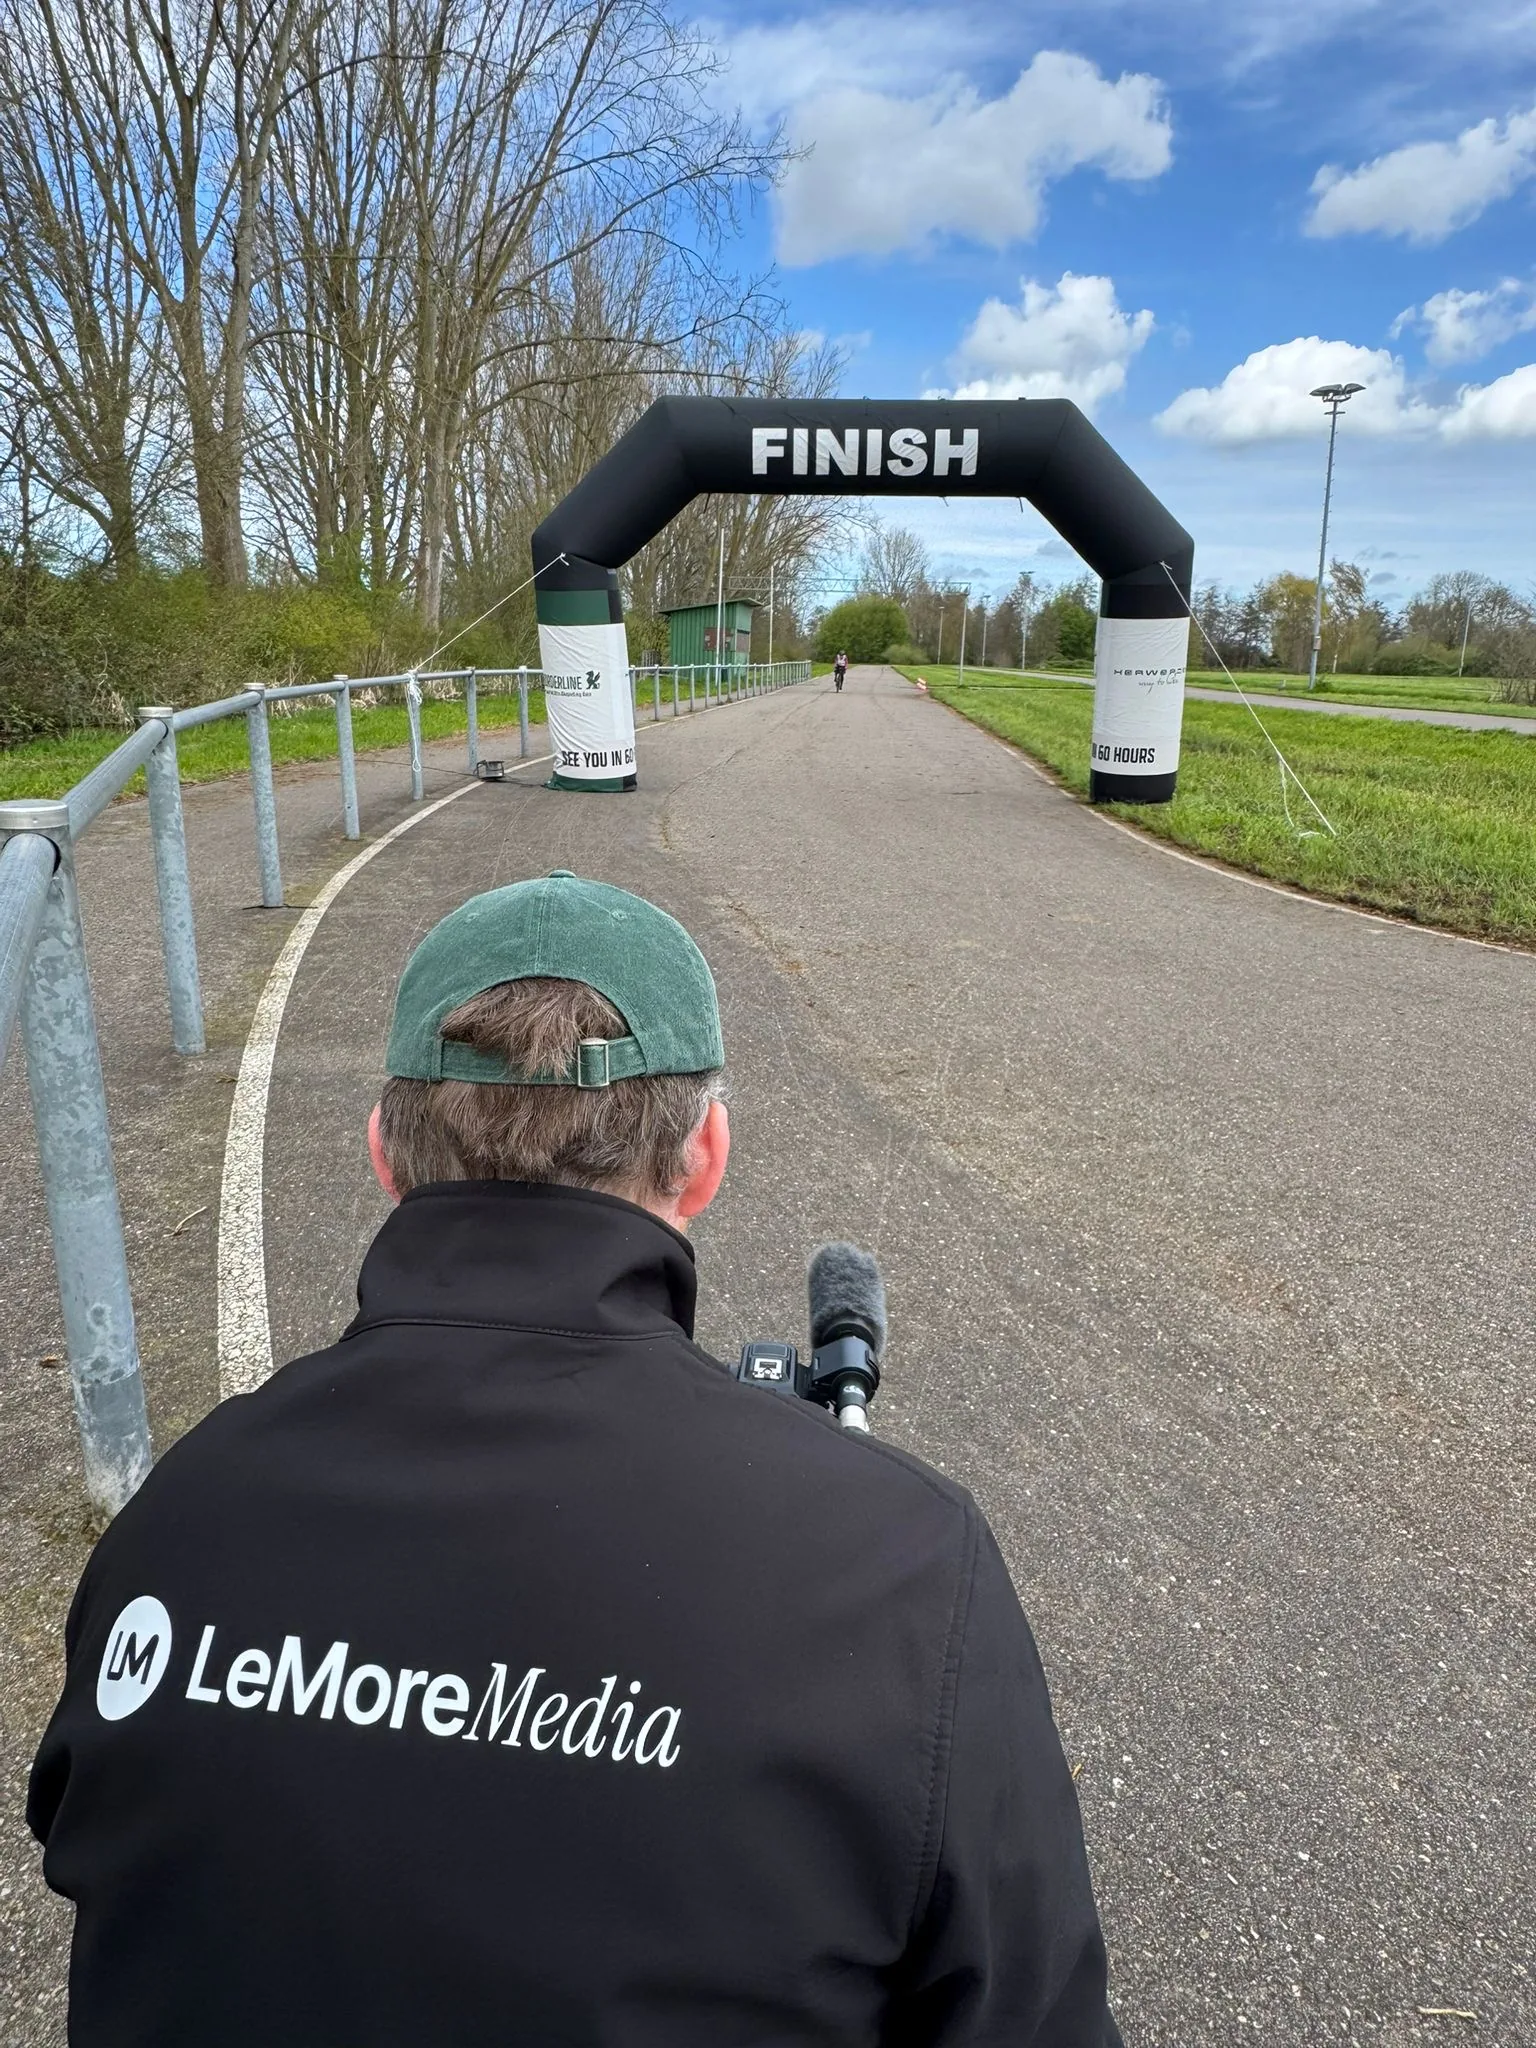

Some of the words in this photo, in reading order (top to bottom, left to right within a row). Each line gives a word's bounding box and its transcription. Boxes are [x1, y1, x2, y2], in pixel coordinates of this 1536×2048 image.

[752, 427, 979, 476] FINISH
[561, 750, 580, 767] SEE
[583, 751, 607, 768] YOU
[611, 749, 622, 766] IN
[625, 747, 634, 764] 60
[1098, 744, 1110, 761] 60
[1113, 746, 1155, 763] HOURS
[185, 1624, 683, 1768] LeMoreMedia
